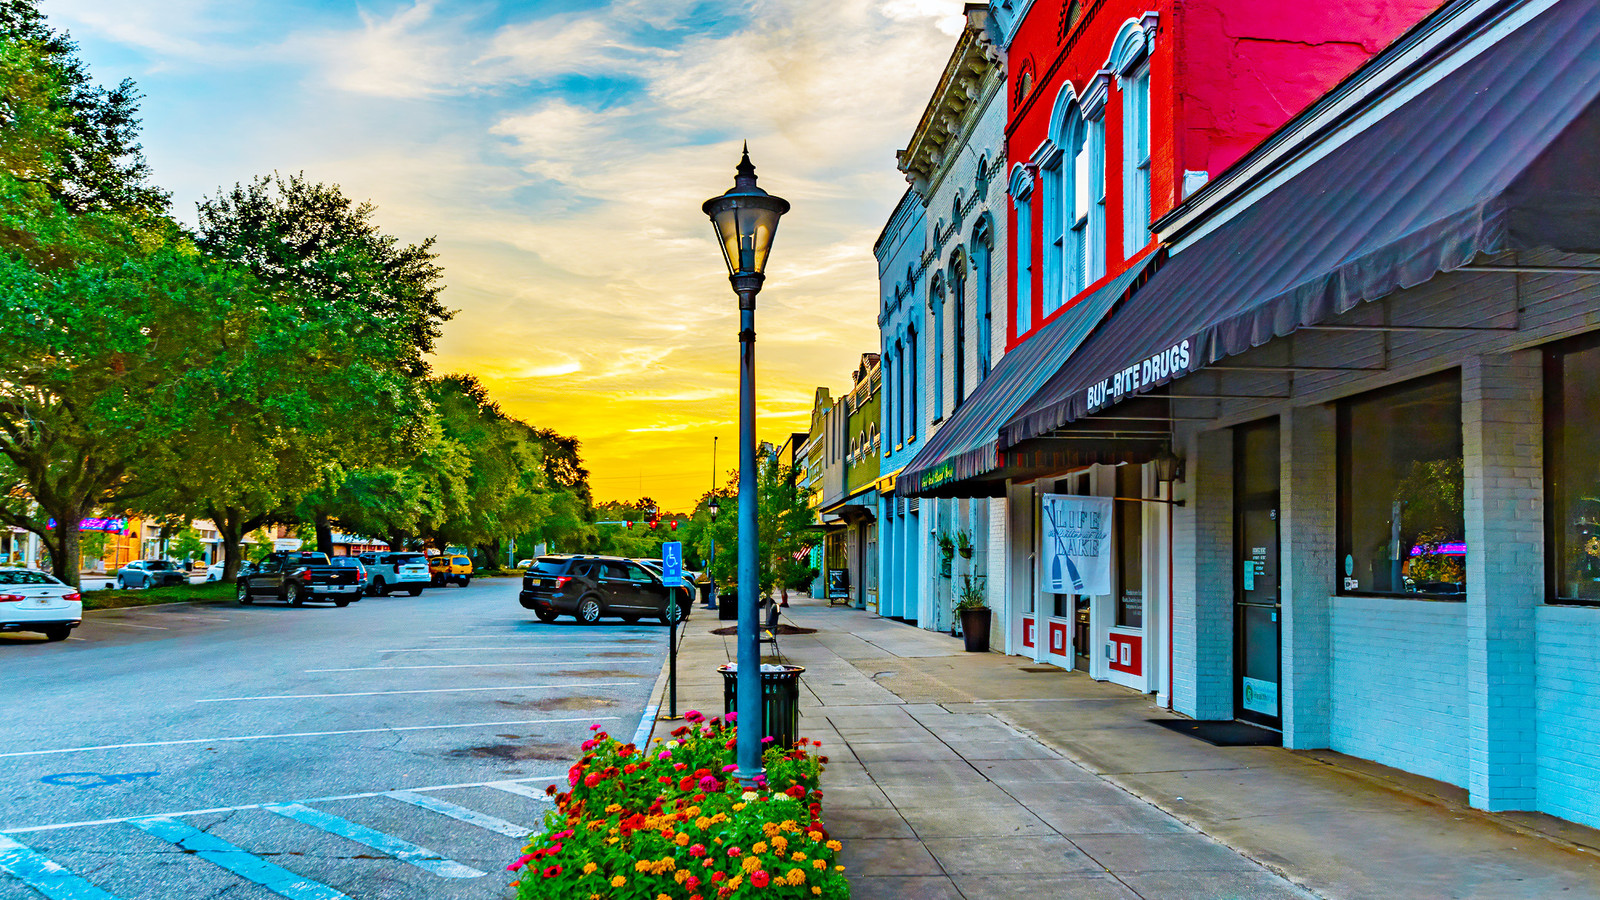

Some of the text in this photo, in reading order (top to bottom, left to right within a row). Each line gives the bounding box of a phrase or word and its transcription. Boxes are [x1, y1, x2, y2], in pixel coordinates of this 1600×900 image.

[1087, 339, 1190, 410] BUY-RITE DRUGS
[1057, 510, 1100, 529] LIFE
[1055, 539, 1099, 557] LAKE
